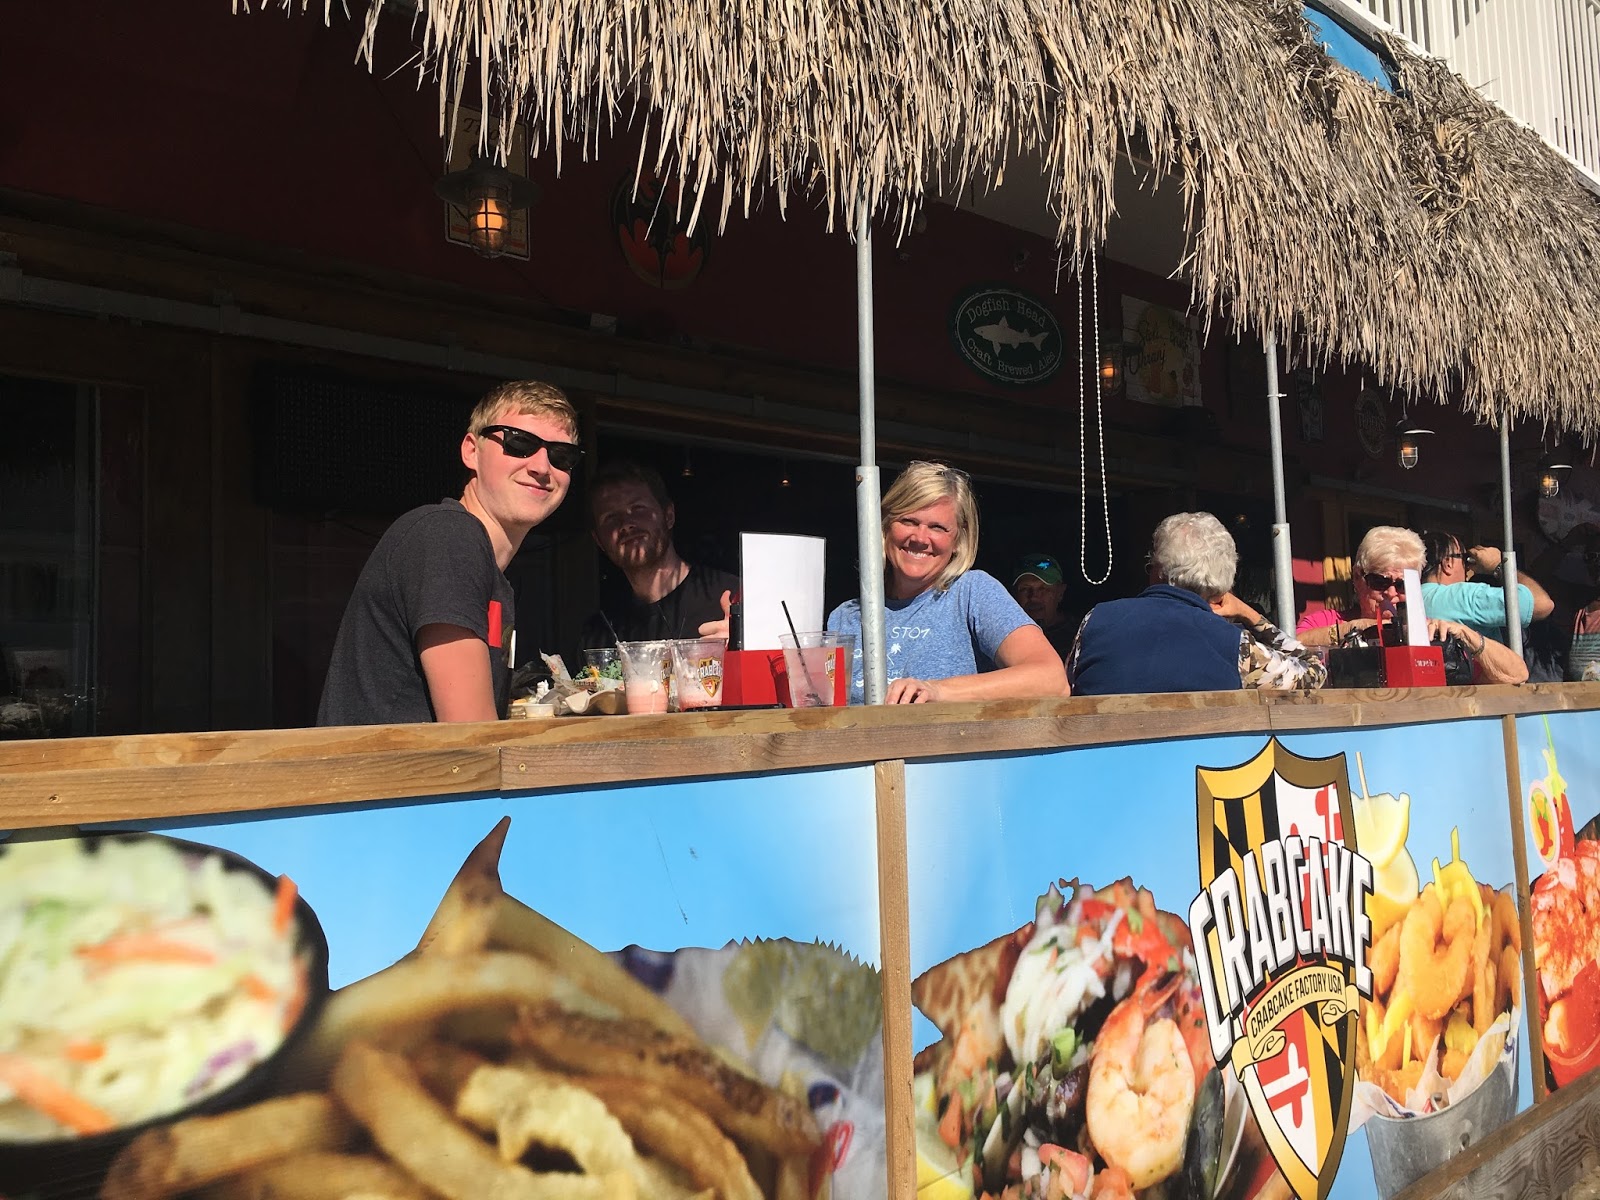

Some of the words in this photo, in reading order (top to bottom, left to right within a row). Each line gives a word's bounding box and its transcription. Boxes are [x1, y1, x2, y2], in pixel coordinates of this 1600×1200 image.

[965, 297, 1010, 324] Dogfish
[1016, 300, 1047, 328] Head
[966, 337, 993, 366] Craft
[997, 360, 1034, 376] Brewed
[1037, 350, 1056, 371] Ales
[1188, 834, 1375, 1064] CRABCAKE
[1250, 982, 1295, 1039] CRABCAKE
[1294, 974, 1328, 1000] FACTORY
[1328, 974, 1343, 996] USA
